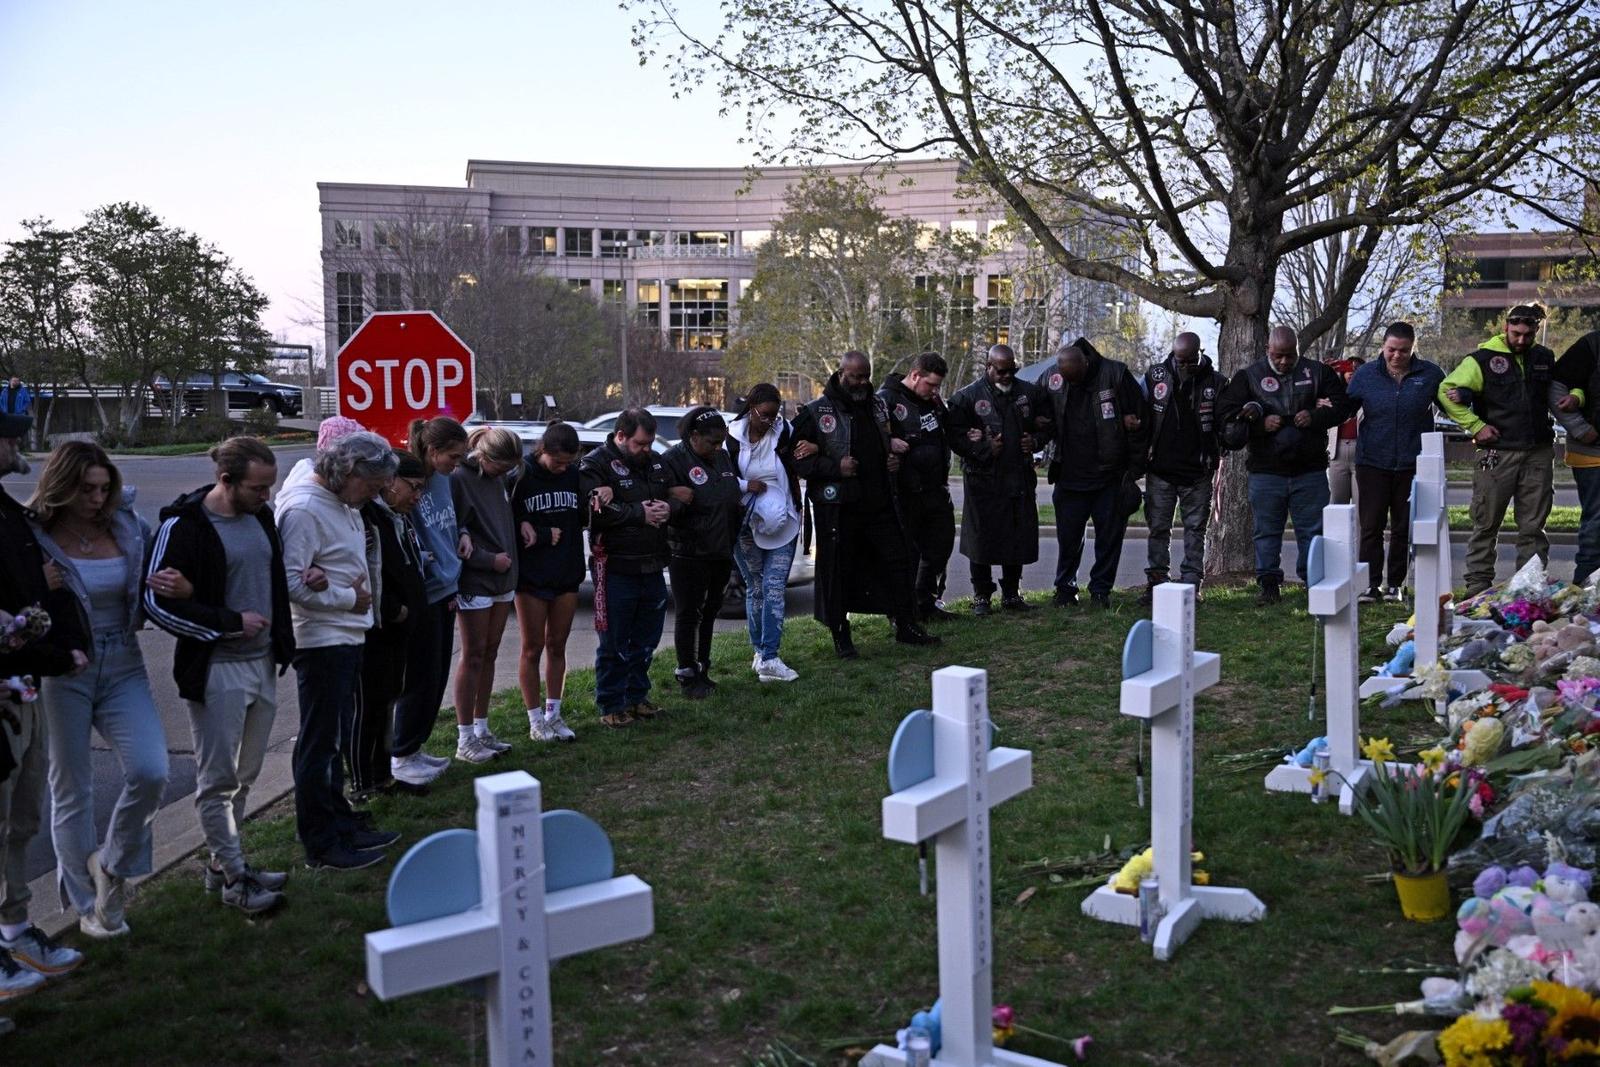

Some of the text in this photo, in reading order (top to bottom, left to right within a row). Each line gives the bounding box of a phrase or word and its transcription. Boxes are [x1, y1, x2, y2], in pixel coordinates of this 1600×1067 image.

[347, 358, 464, 411] STOP
[524, 493, 552, 513] WILD
[511, 825, 528, 922] MERCY
[517, 937, 531, 952] &
[518, 966, 535, 1063] COMPA
